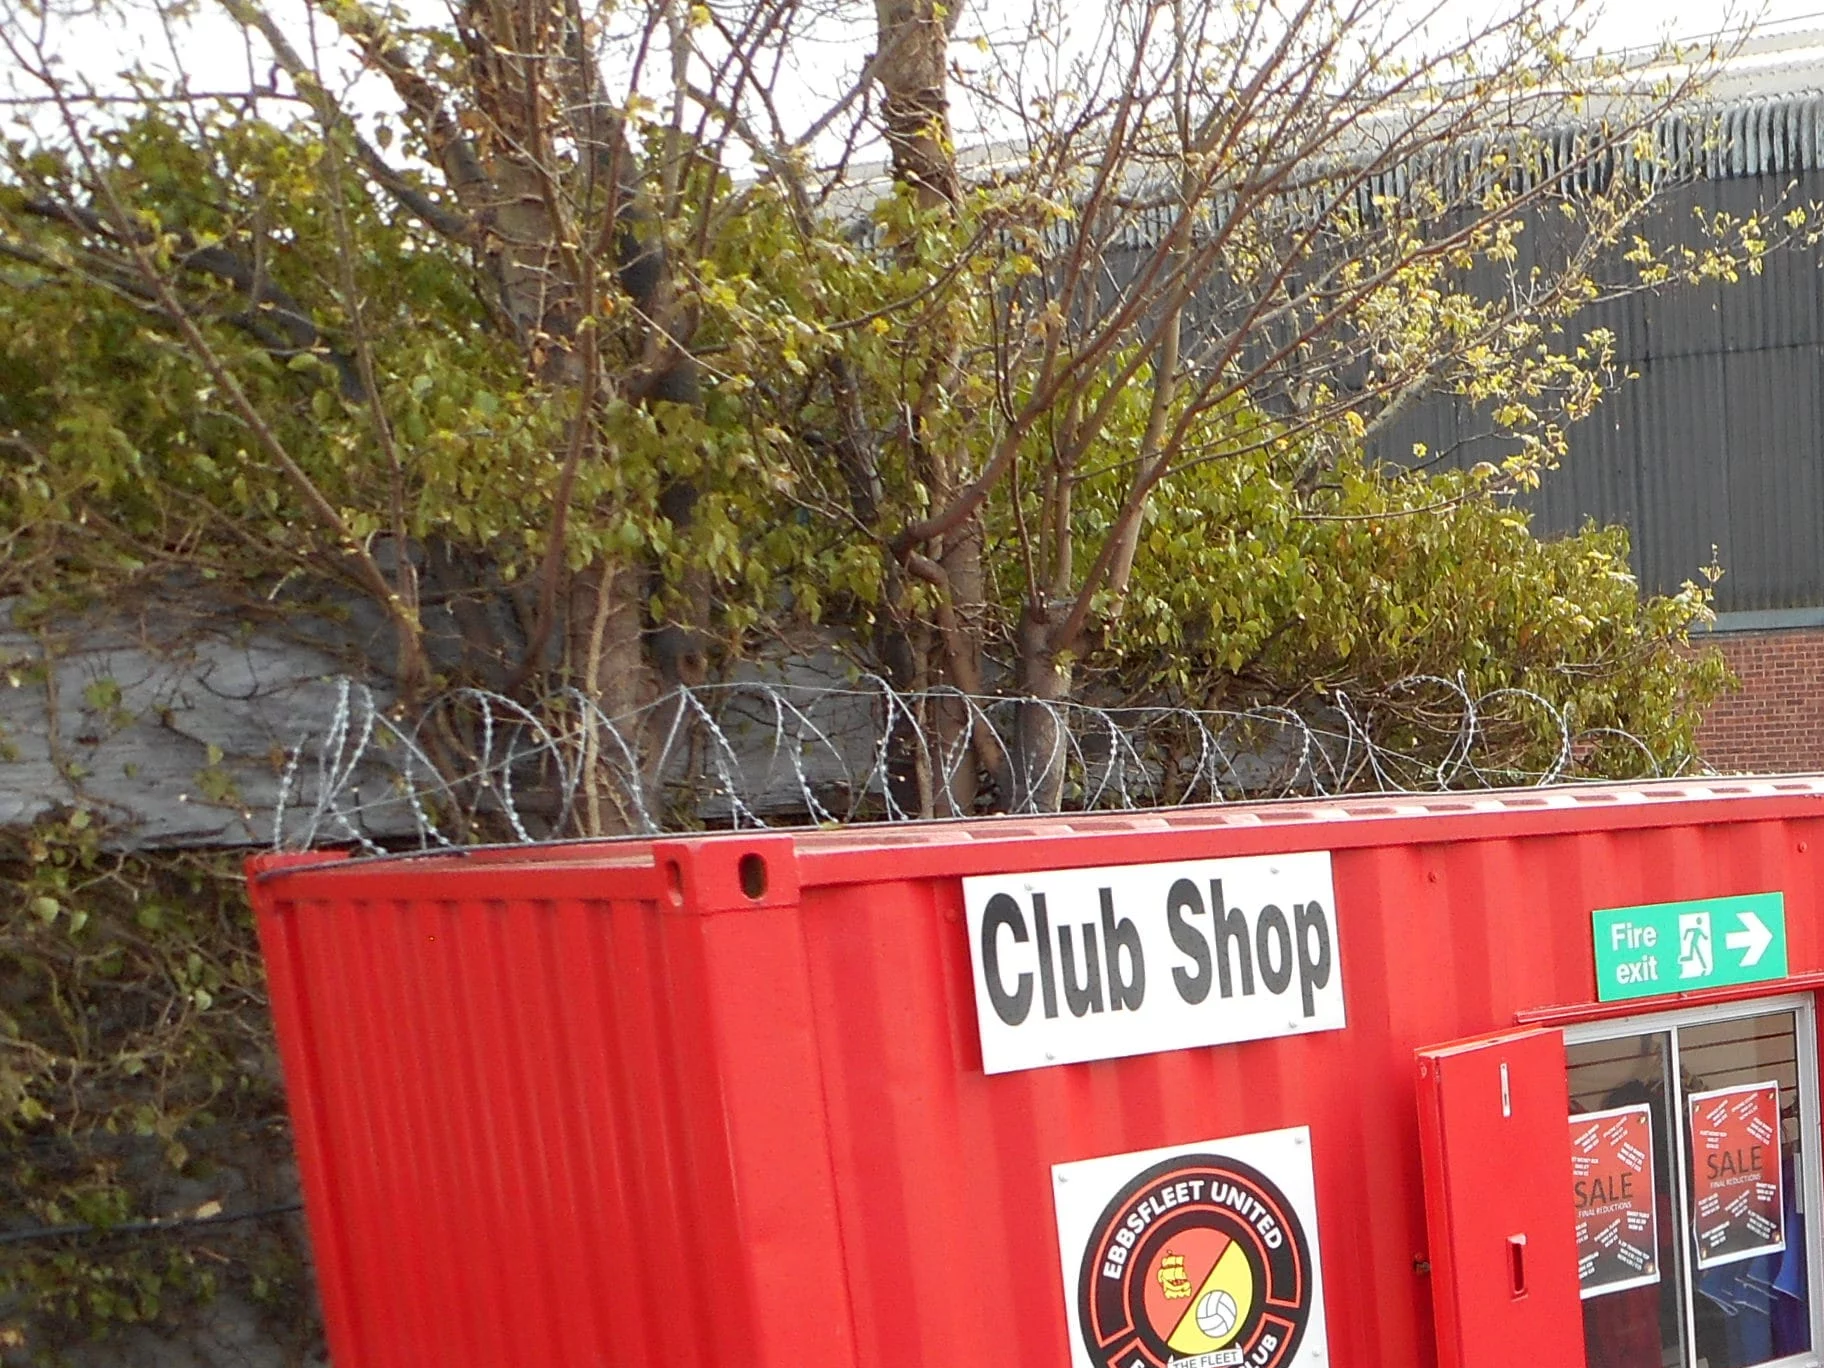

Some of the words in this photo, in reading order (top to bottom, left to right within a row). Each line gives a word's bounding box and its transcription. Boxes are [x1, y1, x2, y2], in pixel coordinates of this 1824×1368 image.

[980, 887, 1146, 1026] Club
[1165, 877, 1332, 1018] Shop
[1611, 922, 1657, 952] Fire
[1616, 954, 1659, 985] exit
[1706, 1145, 1764, 1179] SALE
[1574, 1172, 1633, 1208] SALE
[1710, 1181, 1725, 1189] FINAL
[1726, 1173, 1761, 1186] REDUCTIONS
[1578, 1208, 1596, 1219] FINAL
[1596, 1201, 1632, 1215] REDUCTIONS
[1103, 1180, 1204, 1280] EBBSFLEET
[1210, 1181, 1283, 1249] UNITED
[1200, 1351, 1238, 1368] FLEET
